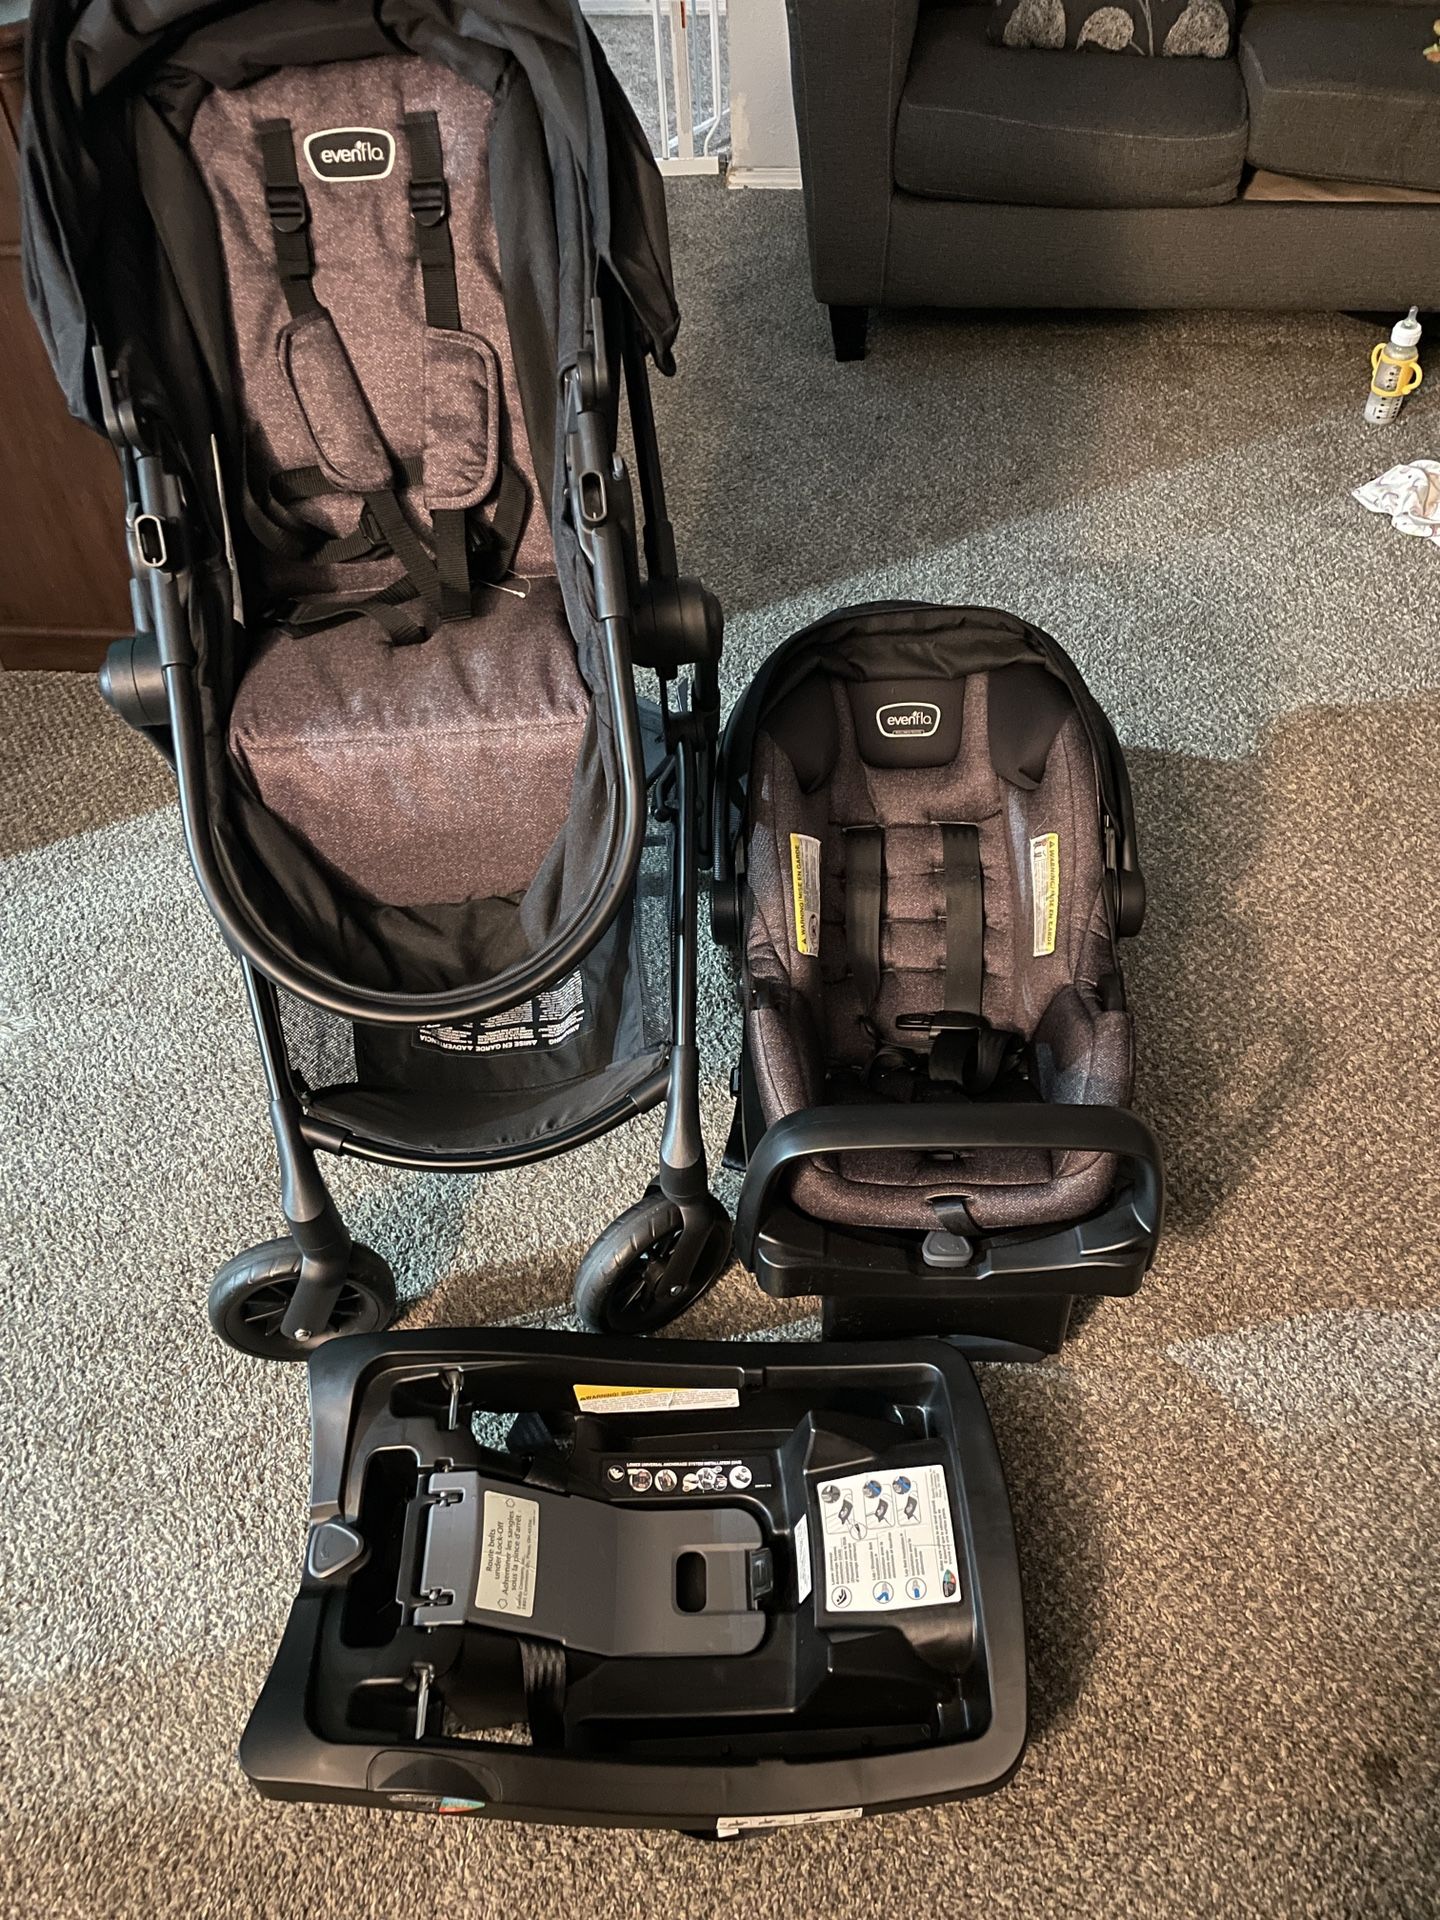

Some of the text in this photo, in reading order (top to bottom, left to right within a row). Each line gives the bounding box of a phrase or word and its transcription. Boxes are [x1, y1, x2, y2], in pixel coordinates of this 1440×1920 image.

[321, 140, 384, 163] evenflo
[887, 711, 932, 725] evenflo
[797, 871, 802, 881] EN
[419, 1034, 468, 1051] ADVERTENCIA
[475, 1040, 531, 1052] MISE EN GARDE
[506, 1511, 515, 1537] sangles
[486, 1528, 496, 1571] Route belts
[494, 1521, 504, 1579] under Lock-Off
[513, 1541, 521, 1563] pince
[502, 1552, 511, 1595] Acheminer
